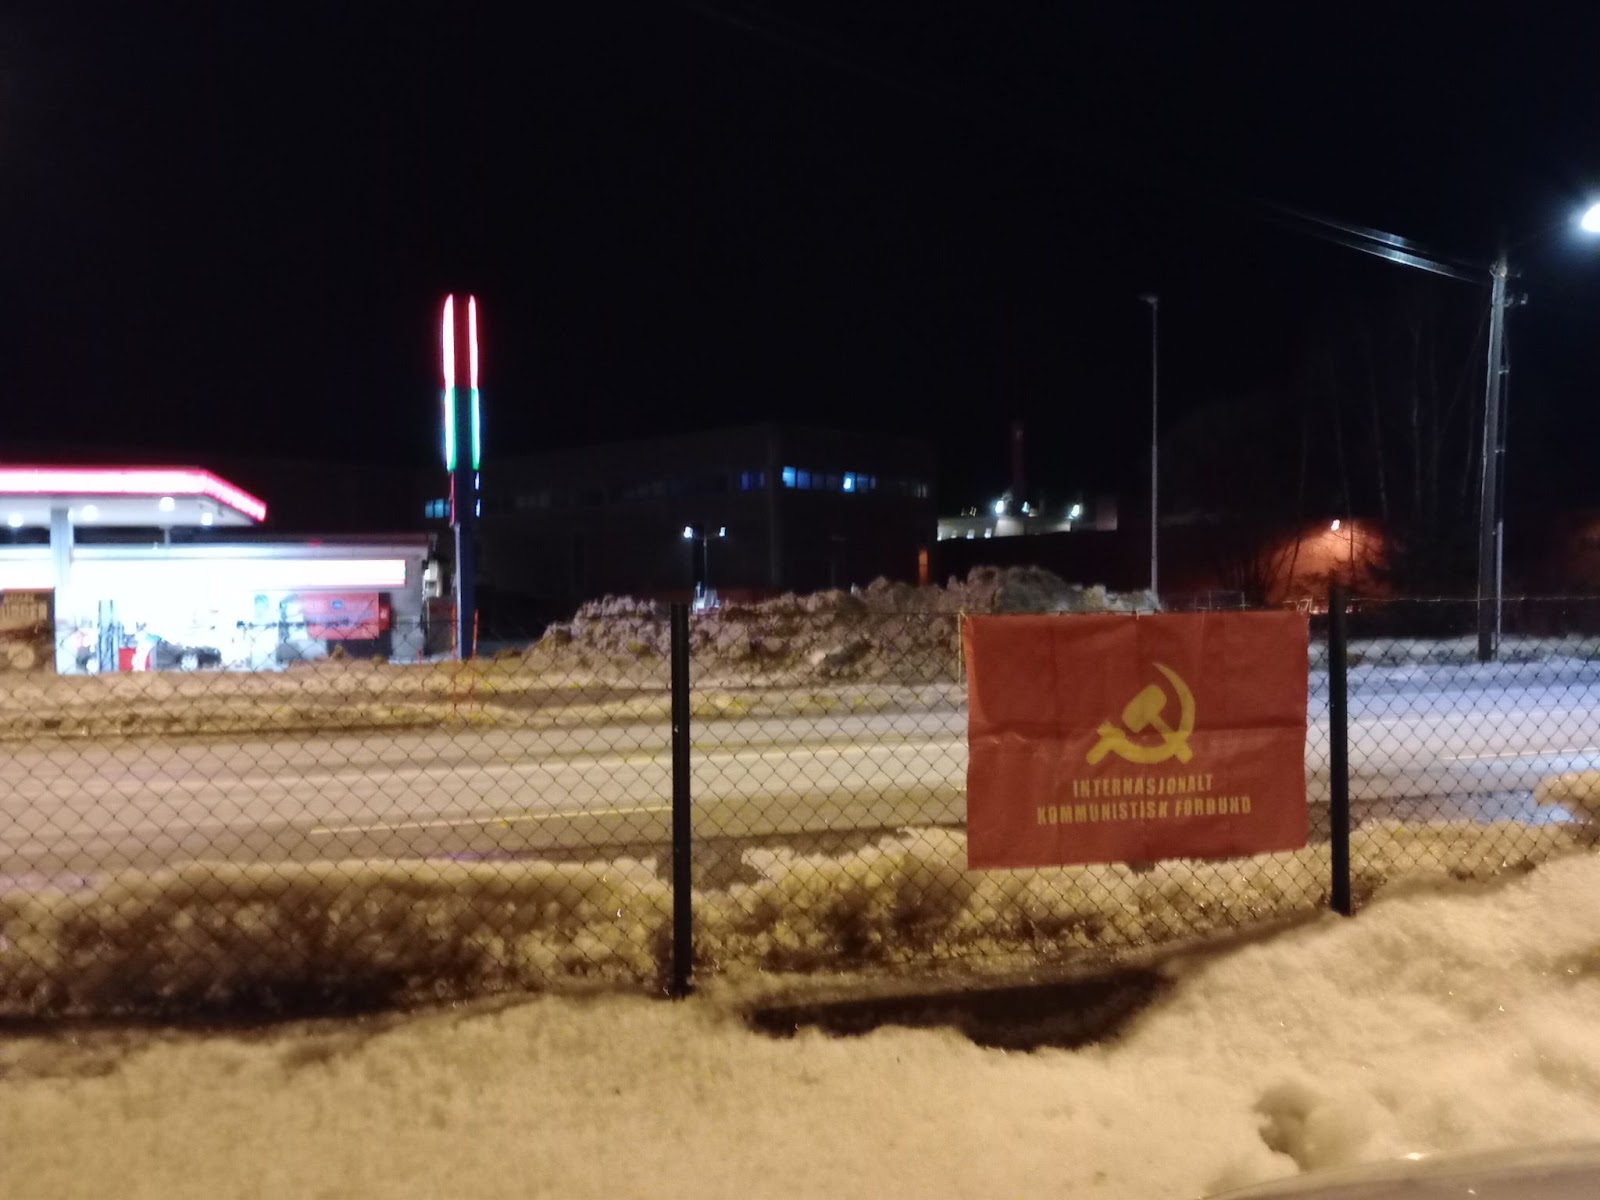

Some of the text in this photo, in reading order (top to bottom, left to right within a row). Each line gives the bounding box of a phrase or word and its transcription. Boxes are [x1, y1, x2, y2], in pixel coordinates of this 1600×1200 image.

[1073, 774, 1213, 798] INTERNASJONALT
[1037, 796, 1251, 825] KOMMUNISTISK FORBUND
